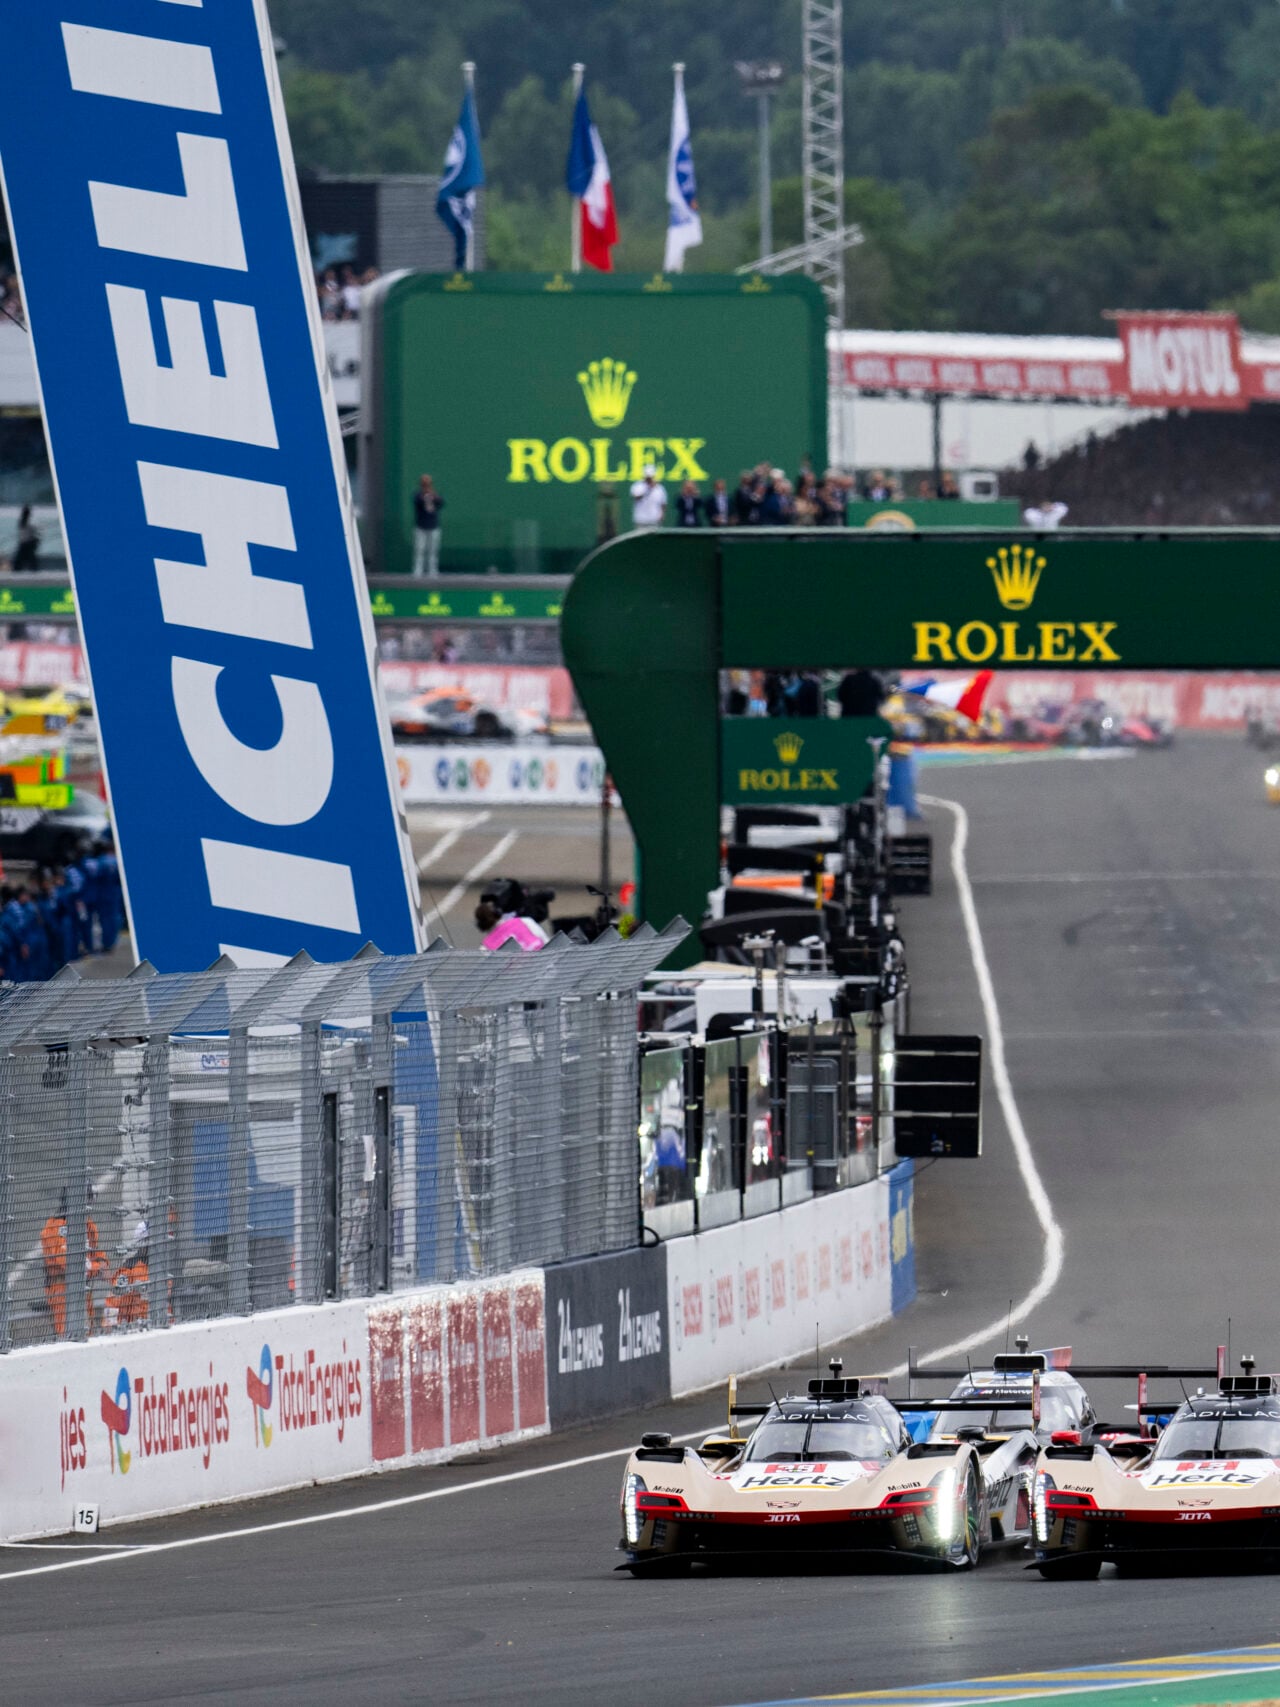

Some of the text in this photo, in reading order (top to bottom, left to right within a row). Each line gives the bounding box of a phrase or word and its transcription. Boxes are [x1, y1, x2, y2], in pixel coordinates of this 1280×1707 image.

[1128, 326, 1240, 396] MOTUL
[507, 437, 708, 483] ROLEX
[61, 0, 372, 1037] ICHELI
[912, 620, 1120, 663] ROLEX
[738, 769, 840, 791] ROLEX
[275, 1338, 362, 1443] TotalEnergies
[134, 1360, 230, 1470] TotalEnergies
[764, 1412, 871, 1423] CADILLAC
[742, 1475, 850, 1488] Hertz
[1151, 1472, 1262, 1486] Hertz
[78, 1510, 94, 1526] 15
[764, 1513, 801, 1523] JOTA
[1174, 1512, 1212, 1521] JOTA
